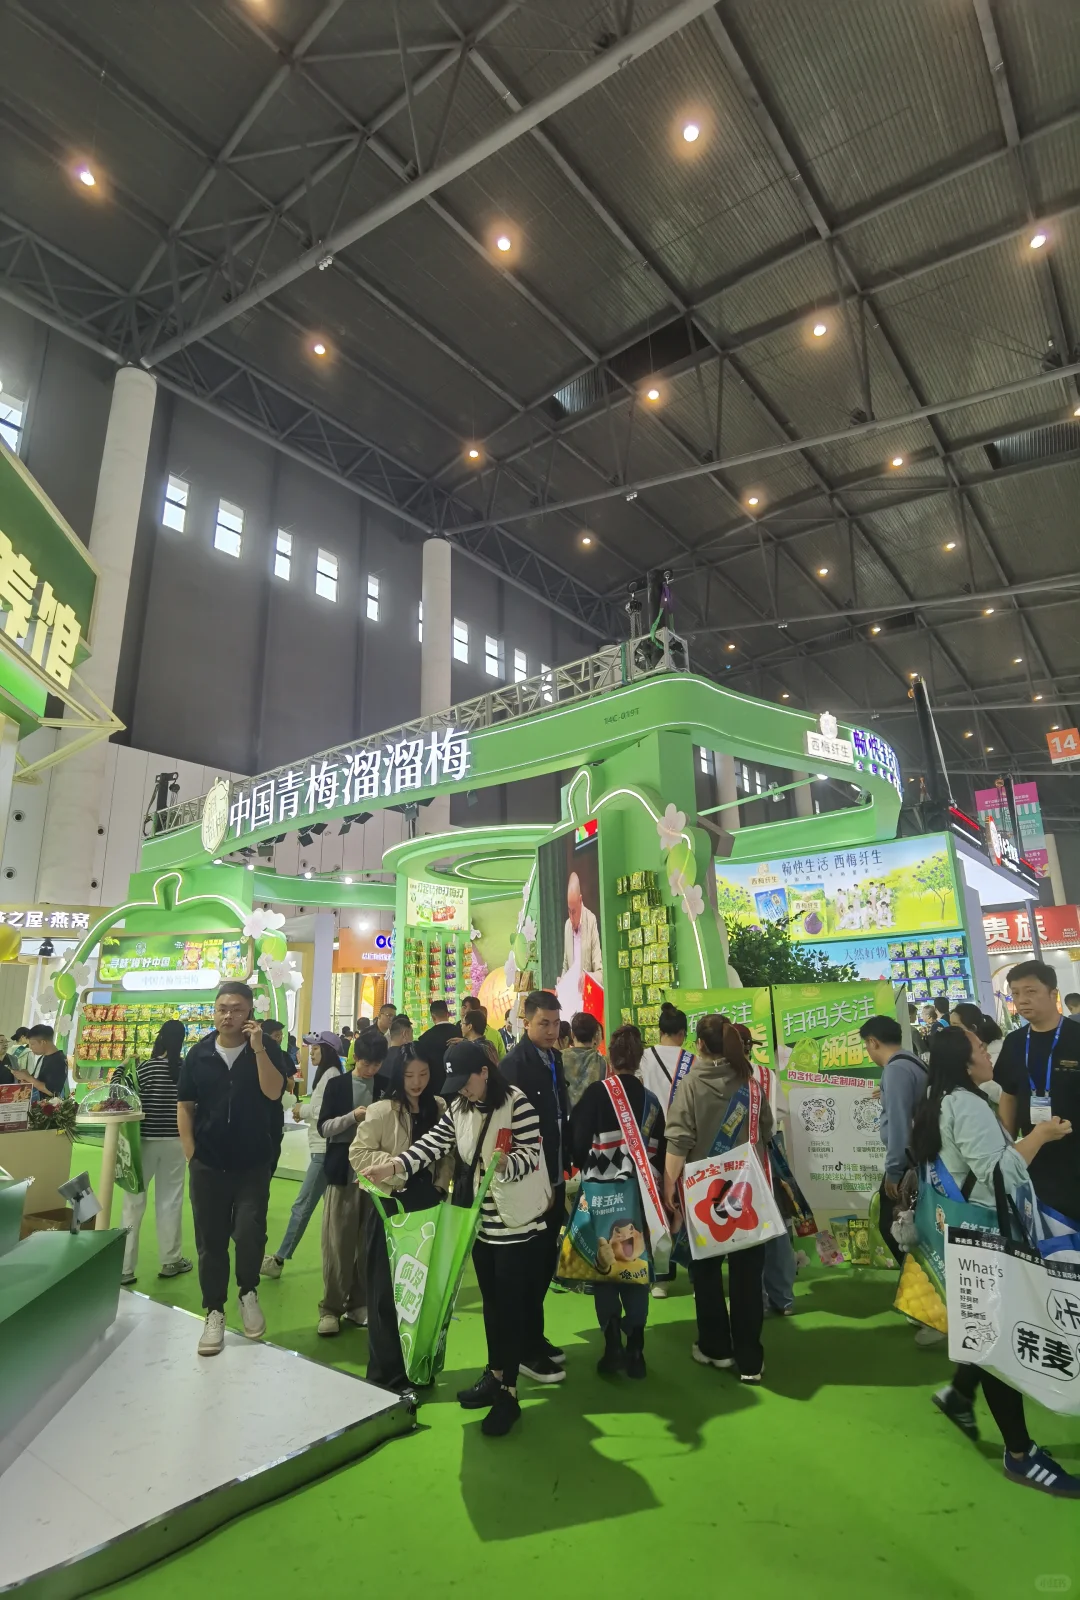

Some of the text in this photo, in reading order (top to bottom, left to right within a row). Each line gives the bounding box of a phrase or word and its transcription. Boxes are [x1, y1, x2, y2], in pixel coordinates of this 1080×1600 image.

[1051, 734, 1077, 753] 14
[230, 727, 472, 838] 中国青梅溜溜梅
[781, 849, 883, 876] 畅快生活 西梅纤生
[782, 995, 876, 1037] 扫码关注
[843, 1163, 858, 1172] 抖音
[591, 1193, 624, 1208] 鲜玉米
[400, 1260, 425, 1290] 你没
[958, 1257, 1004, 1278] What's
[959, 1273, 972, 1287] in
[975, 1276, 986, 1290] it
[1017, 1327, 1075, 1378] 荞麦
